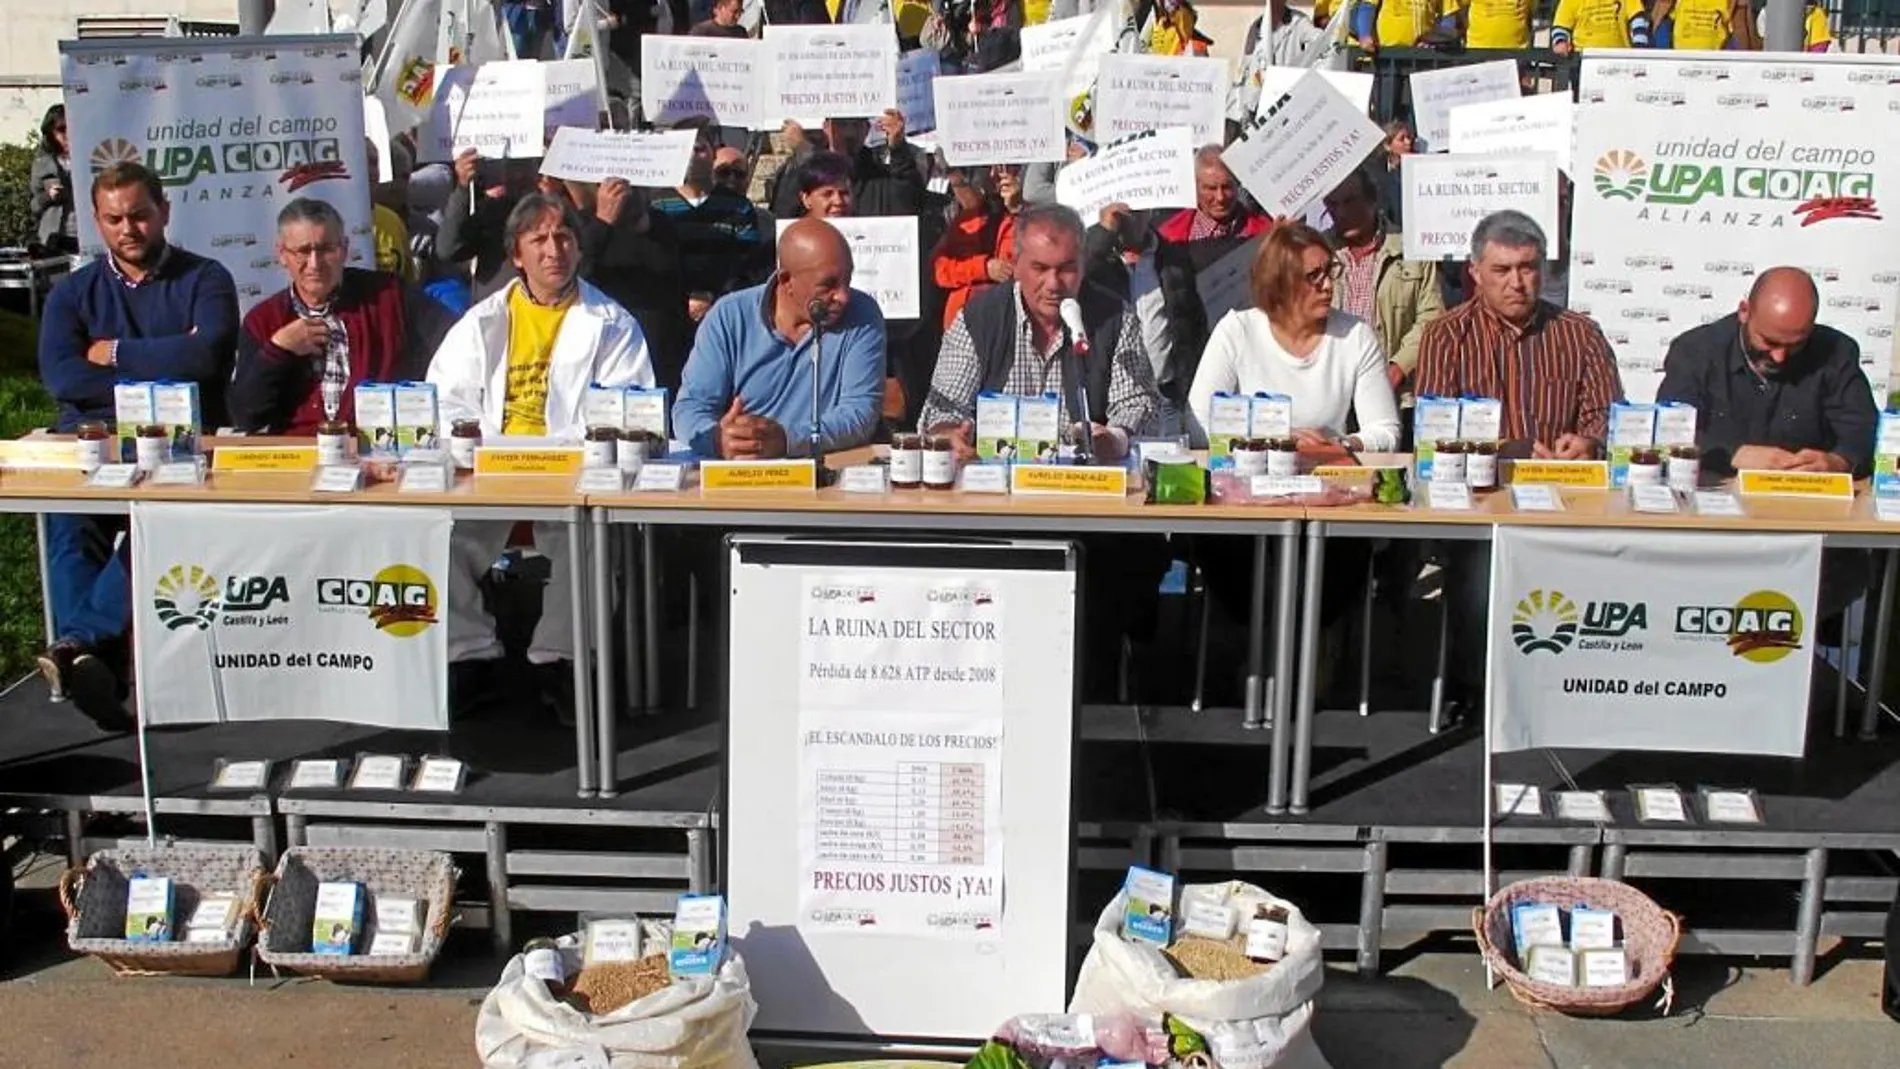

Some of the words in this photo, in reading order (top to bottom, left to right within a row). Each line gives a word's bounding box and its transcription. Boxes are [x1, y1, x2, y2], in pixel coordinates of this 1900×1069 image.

[147, 116, 221, 141] unidad
[229, 115, 261, 137] del
[269, 117, 337, 137] campo
[146, 143, 217, 176] UPA
[222, 138, 340, 174] COAG
[1656, 137, 1738, 160] unidad
[1746, 139, 1785, 161] del
[1792, 146, 1875, 169] campo
[1418, 183, 1433, 196] LA
[1436, 183, 1469, 196] RUINA
[1473, 182, 1493, 196] DEL
[1498, 181, 1540, 195] SECTOR
[1648, 164, 1725, 199] UPA
[1734, 167, 1874, 201] COAG
[1637, 208, 1784, 228] ALIANZA
[1422, 232, 1468, 247] PRECIOS
[225, 576, 290, 604] UPA
[317, 578, 428, 606] COAG
[223, 615, 257, 627] Castilla
[258, 617, 265, 628] y
[1582, 602, 1648, 630] UPA
[1675, 606, 1794, 634] COAG
[808, 617, 830, 636] LA
[835, 618, 888, 638] RUINA
[893, 620, 926, 639] DEL
[931, 621, 995, 640] SECTOR
[1578, 639, 1612, 651] Castilla
[1613, 641, 1620, 652] y
[215, 653, 281, 669] UNIDAD
[286, 653, 311, 667] del
[317, 653, 373, 671] CAMPO
[810, 663, 850, 680] Pérdida
[854, 664, 867, 680] de
[905, 666, 931, 681] ATP
[934, 667, 965, 682] desde
[969, 668, 996, 683] 2008
[1563, 679, 1628, 694] UNIDAD
[1634, 681, 1659, 696] del
[1664, 682, 1727, 698] CAMPO
[826, 731, 897, 747] ESCANDALO
[900, 733, 915, 747] DE
[919, 734, 941, 748] LOS
[813, 871, 885, 892] PRECIOS
[889, 873, 951, 895] JUSTOS
[957, 877, 993, 900] ¡YA!
